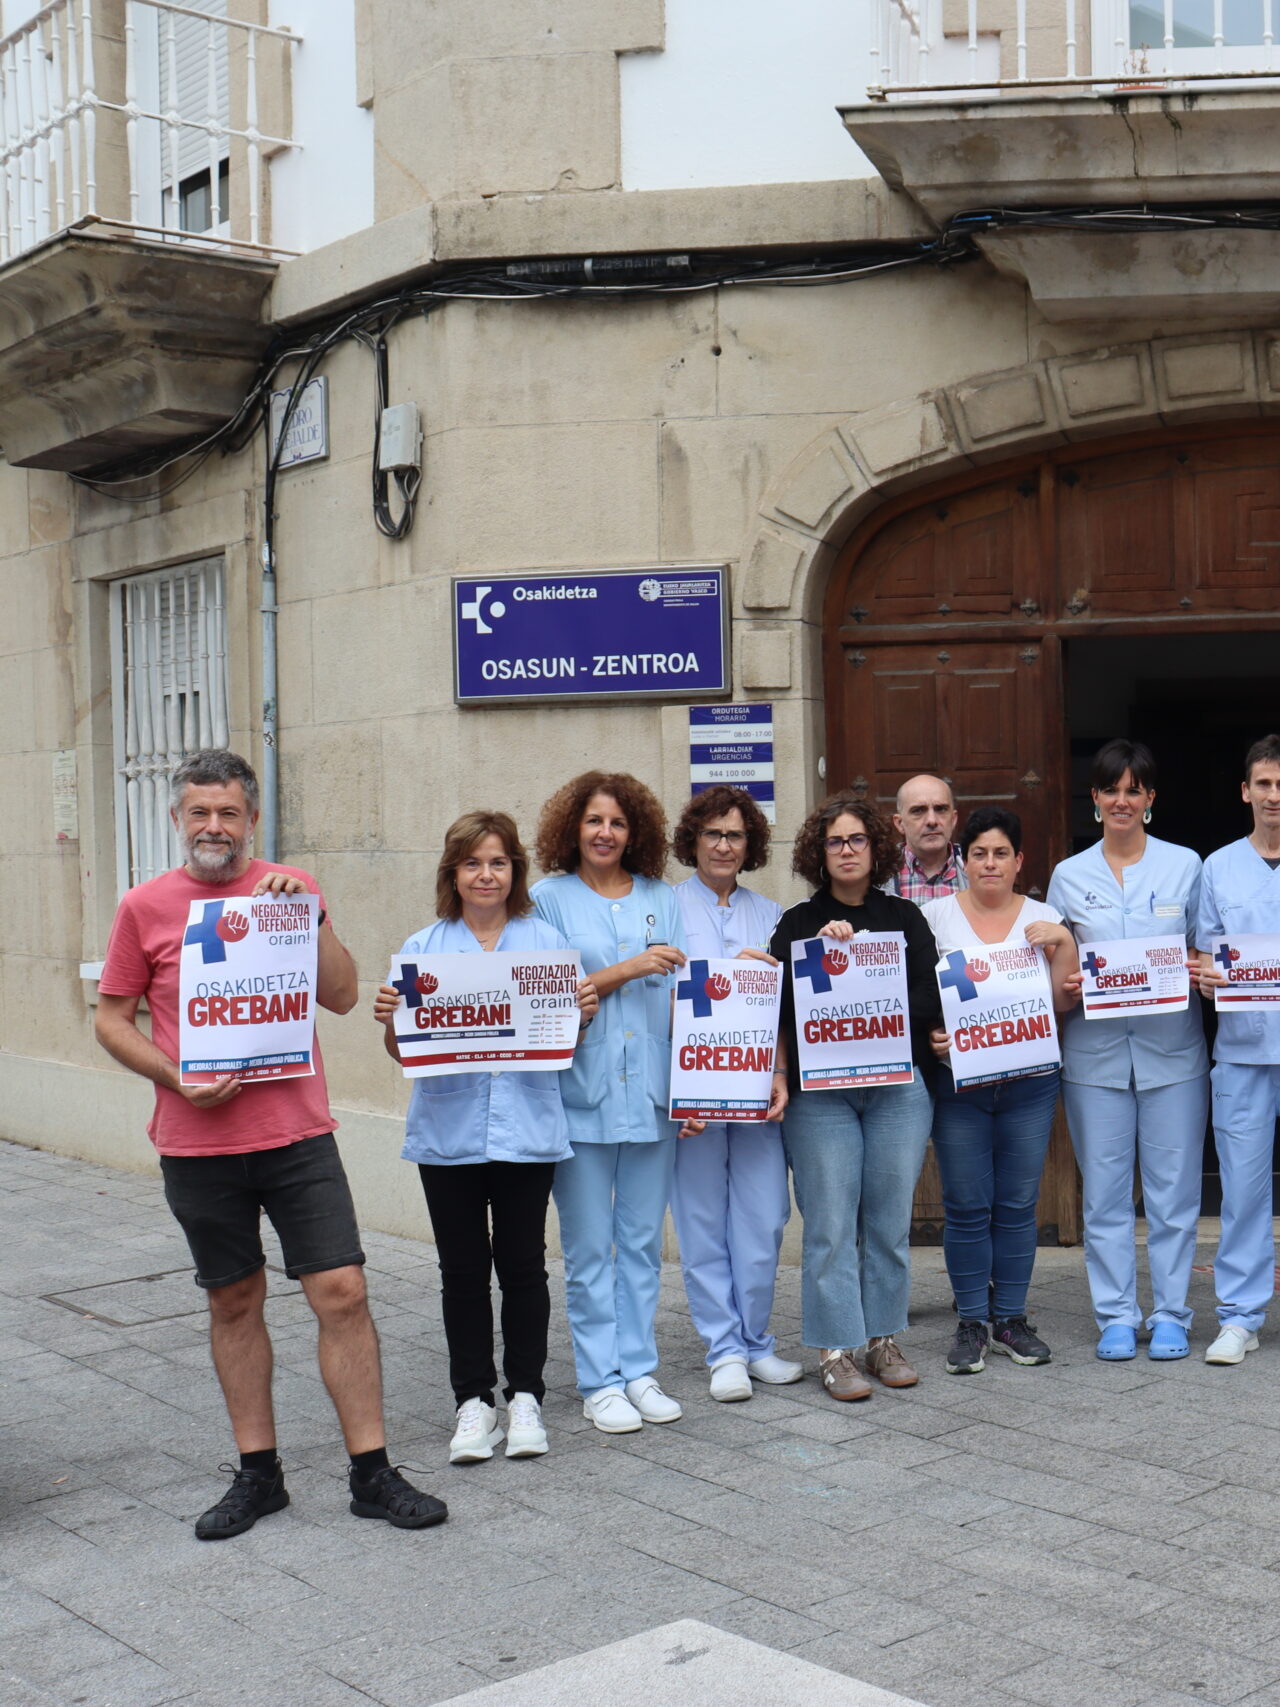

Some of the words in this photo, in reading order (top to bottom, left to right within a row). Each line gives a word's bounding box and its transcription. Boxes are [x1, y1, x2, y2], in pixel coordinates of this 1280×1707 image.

[512, 584, 598, 601] Osakidetza
[481, 656, 576, 680] OSASUN
[592, 652, 700, 676] ZENTROA
[714, 714, 747, 722] HORARIO
[709, 770, 723, 778] 944
[251, 903, 310, 918] NEGOZIAZIOA
[258, 918, 310, 932] DEFENDATU
[269, 932, 310, 946] orain!
[850, 941, 899, 956] NEGOZIAZIOA
[988, 947, 1036, 962] NEGOZIAZIOA
[1146, 947, 1182, 958] NEGOZIAZIOA
[856, 953, 900, 966] DEFENDATU
[996, 956, 1038, 972] DEFENDATU
[1150, 956, 1182, 967] DEFENDATU
[1234, 959, 1280, 970] OSAKIDETZA
[512, 964, 577, 981] NEGOZIAZIOA
[732, 970, 778, 982] NEGOZIAZIOA
[865, 966, 900, 978] orain!
[1007, 967, 1040, 981] orain!
[1102, 964, 1147, 976] OSAKIDETZA
[1158, 966, 1184, 974] orain!
[196, 971, 310, 999] OSAKIDETZA
[518, 978, 576, 996] DEFENDATU
[1096, 972, 1148, 989] GREBAN!
[738, 982, 778, 996] DEFENDATU
[427, 990, 511, 1008] OSAKIDETZA
[530, 996, 577, 1010] orain!
[746, 995, 776, 1007] orain!
[188, 992, 308, 1027] GREBAN!
[415, 1004, 511, 1029] GREBAN!
[810, 998, 903, 1021] OSAKIDETZA
[958, 998, 1048, 1029] OSAKIDETZA
[804, 1014, 904, 1044] GREBAN!
[954, 1014, 1052, 1052] GREBAN!
[687, 1030, 774, 1048] OSAKIDETZA
[680, 1046, 773, 1072] GREBAN!
